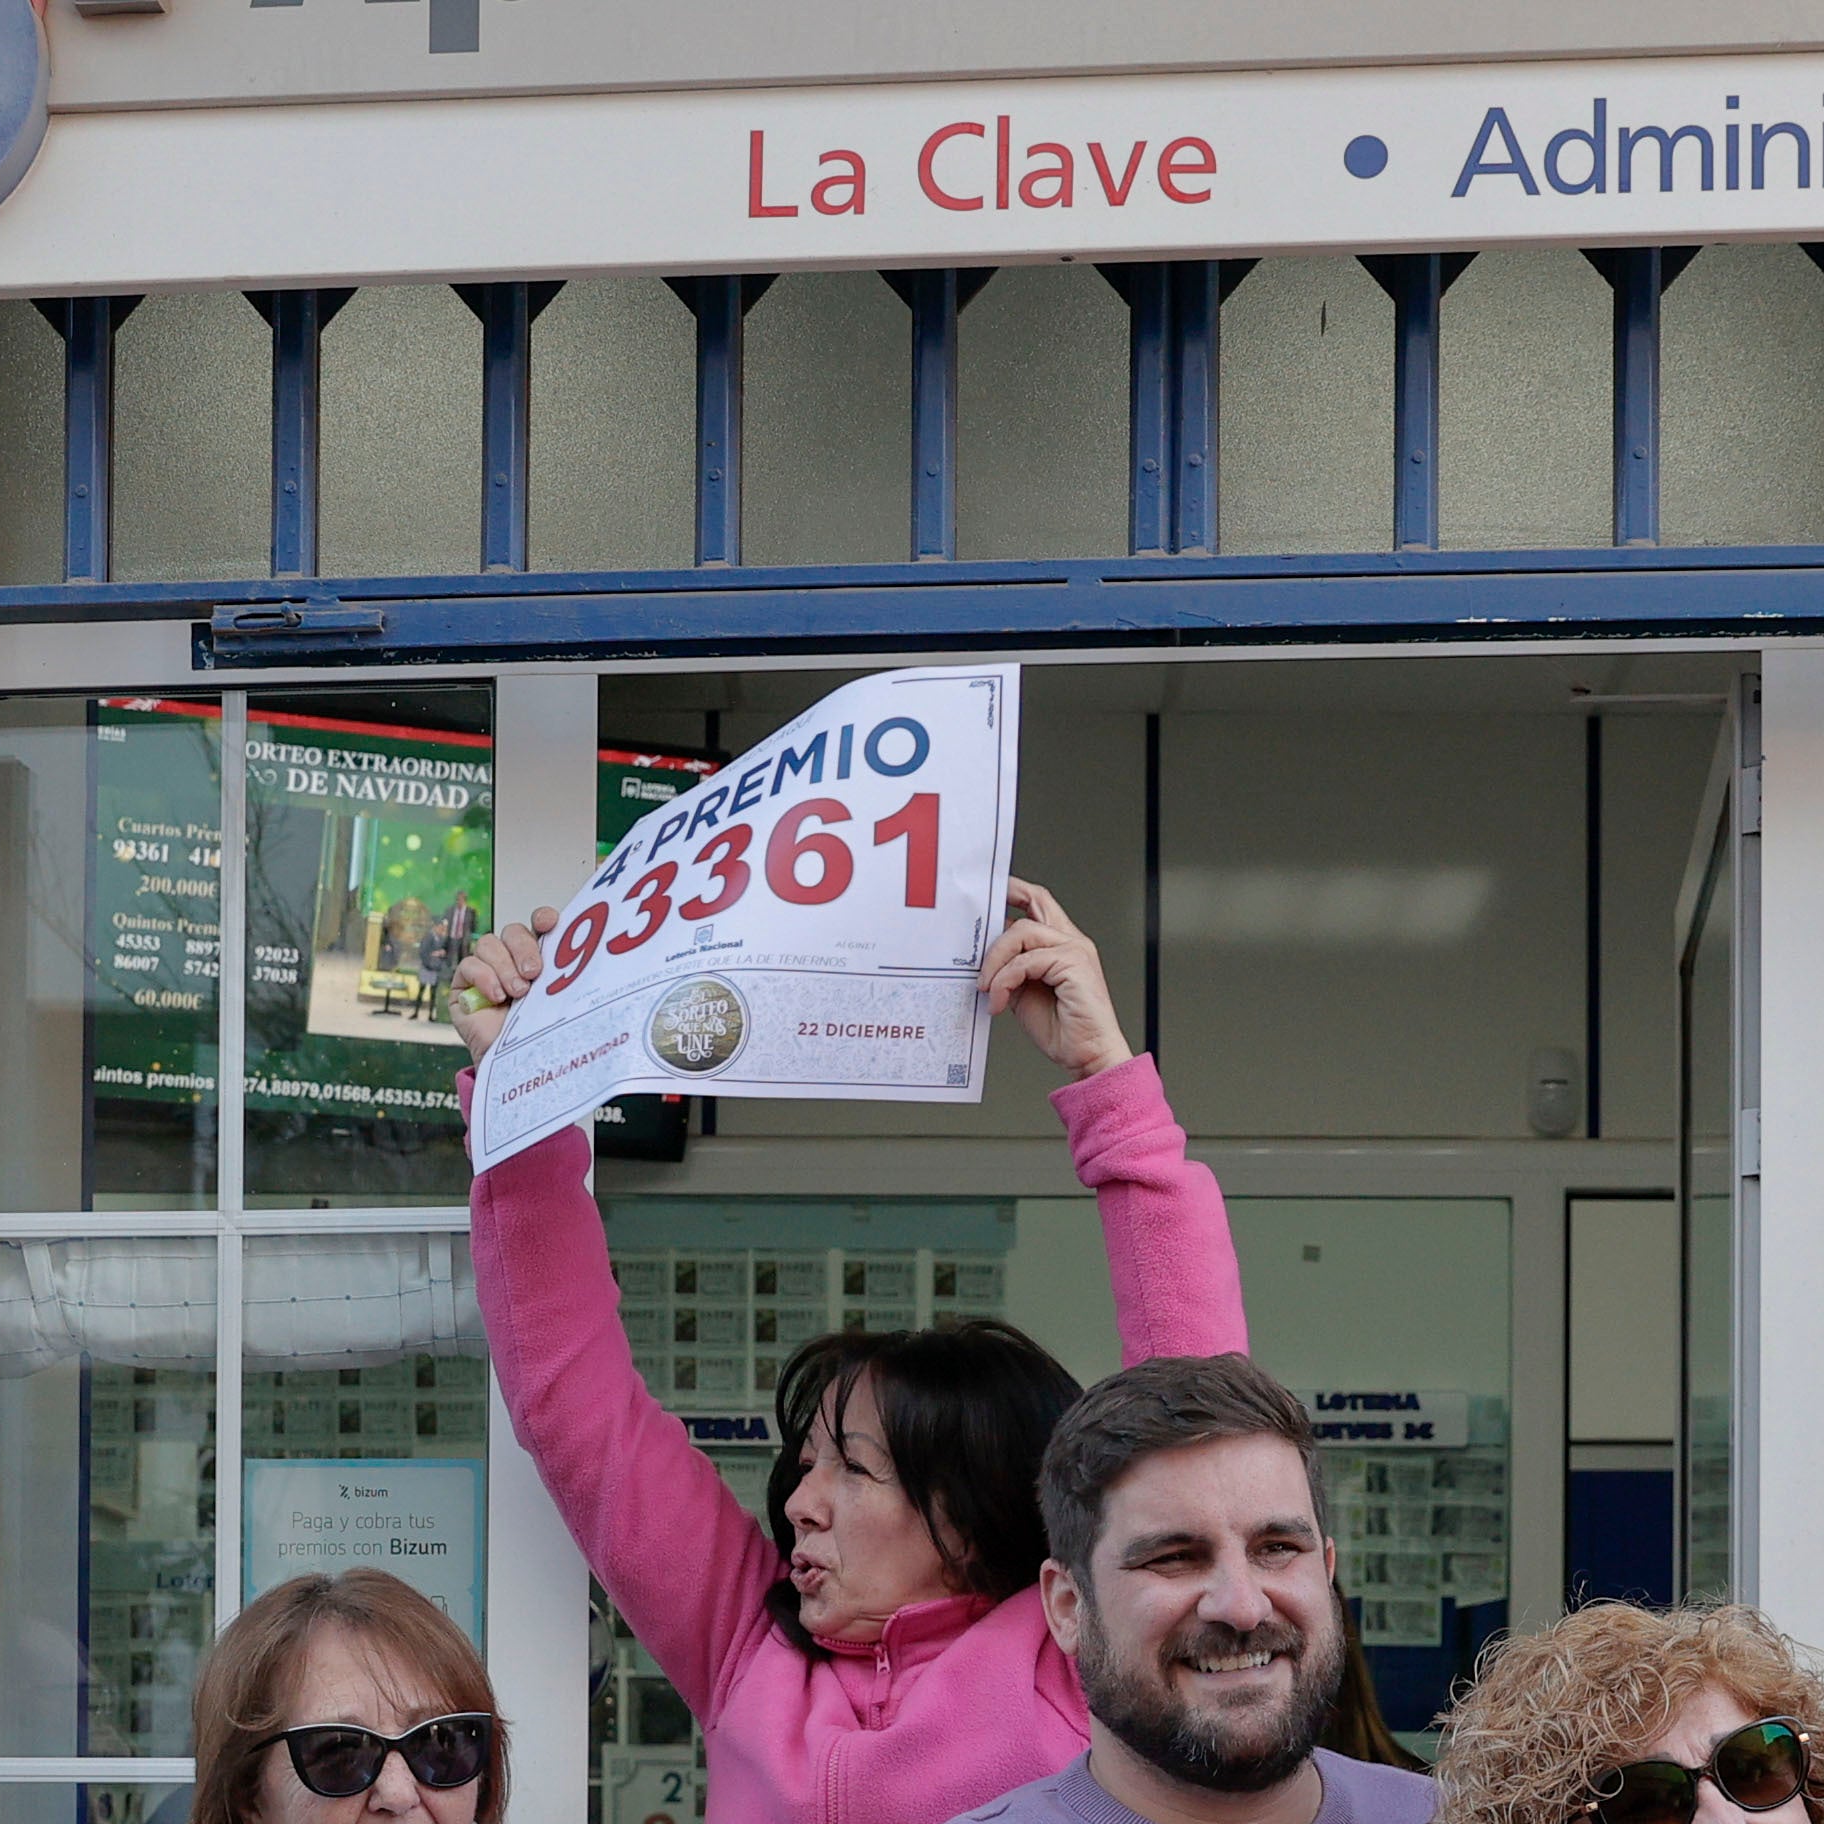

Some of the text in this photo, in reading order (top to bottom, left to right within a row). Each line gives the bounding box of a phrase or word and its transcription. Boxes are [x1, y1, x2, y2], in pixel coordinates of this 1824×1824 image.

[747, 129, 867, 220] La
[916, 115, 1217, 216] Clave
[245, 740, 492, 785] ORTEO EXTRAORDINA
[286, 768, 470, 810] DE NAVIDAD
[647, 716, 931, 865] PREMIO
[545, 792, 941, 996] 93361
[112, 912, 175, 932] Quintos
[185, 938, 221, 957] 8897
[183, 960, 220, 978] 5742
[797, 1022, 926, 1040] 22 DICIEMBRE
[147, 1071, 216, 1091] premios
[354, 1486, 389, 1498] bizum
[291, 1511, 435, 1533] Paga y cobra tus
[278, 1538, 448, 1559] premios con Bizum
